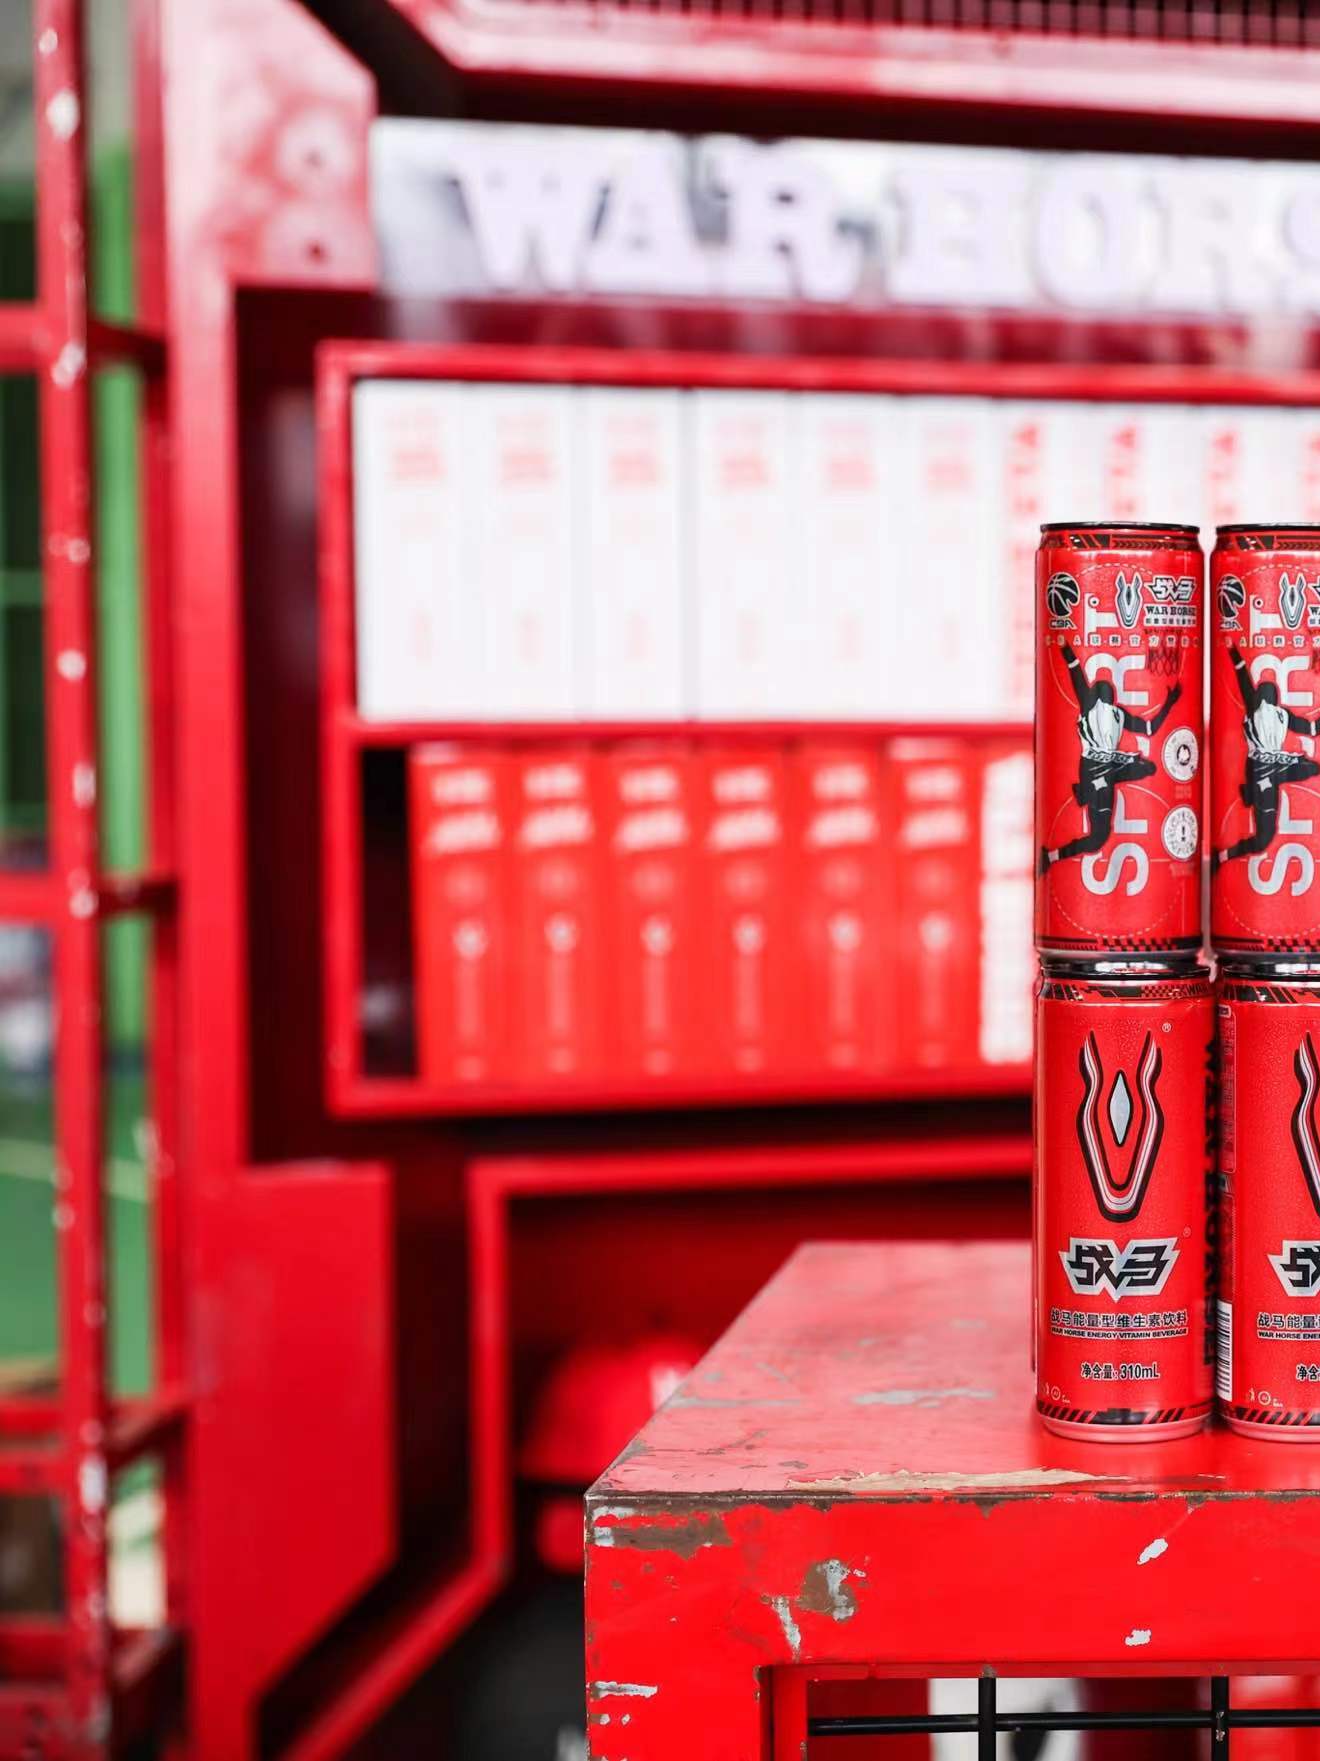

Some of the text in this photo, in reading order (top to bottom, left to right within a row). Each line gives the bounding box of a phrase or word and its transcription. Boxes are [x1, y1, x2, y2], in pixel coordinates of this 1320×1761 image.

[450, 140, 876, 298] WAR
[1145, 605, 1197, 617] WAR HORSE
[1051, 619, 1076, 629] CBA
[1066, 1243, 1173, 1292] 战马
[1051, 1307, 1187, 1328] 战马能量型维生素饮料
[1063, 1328, 1086, 1338] HORSE
[1119, 1331, 1151, 1339] VITAMIN
[1151, 1327, 1188, 1338] BEVERAGE
[1258, 1331, 1274, 1339] WAR
[1275, 1332, 1301, 1340] HORSE
[1120, 1363, 1160, 1379] 310mL
